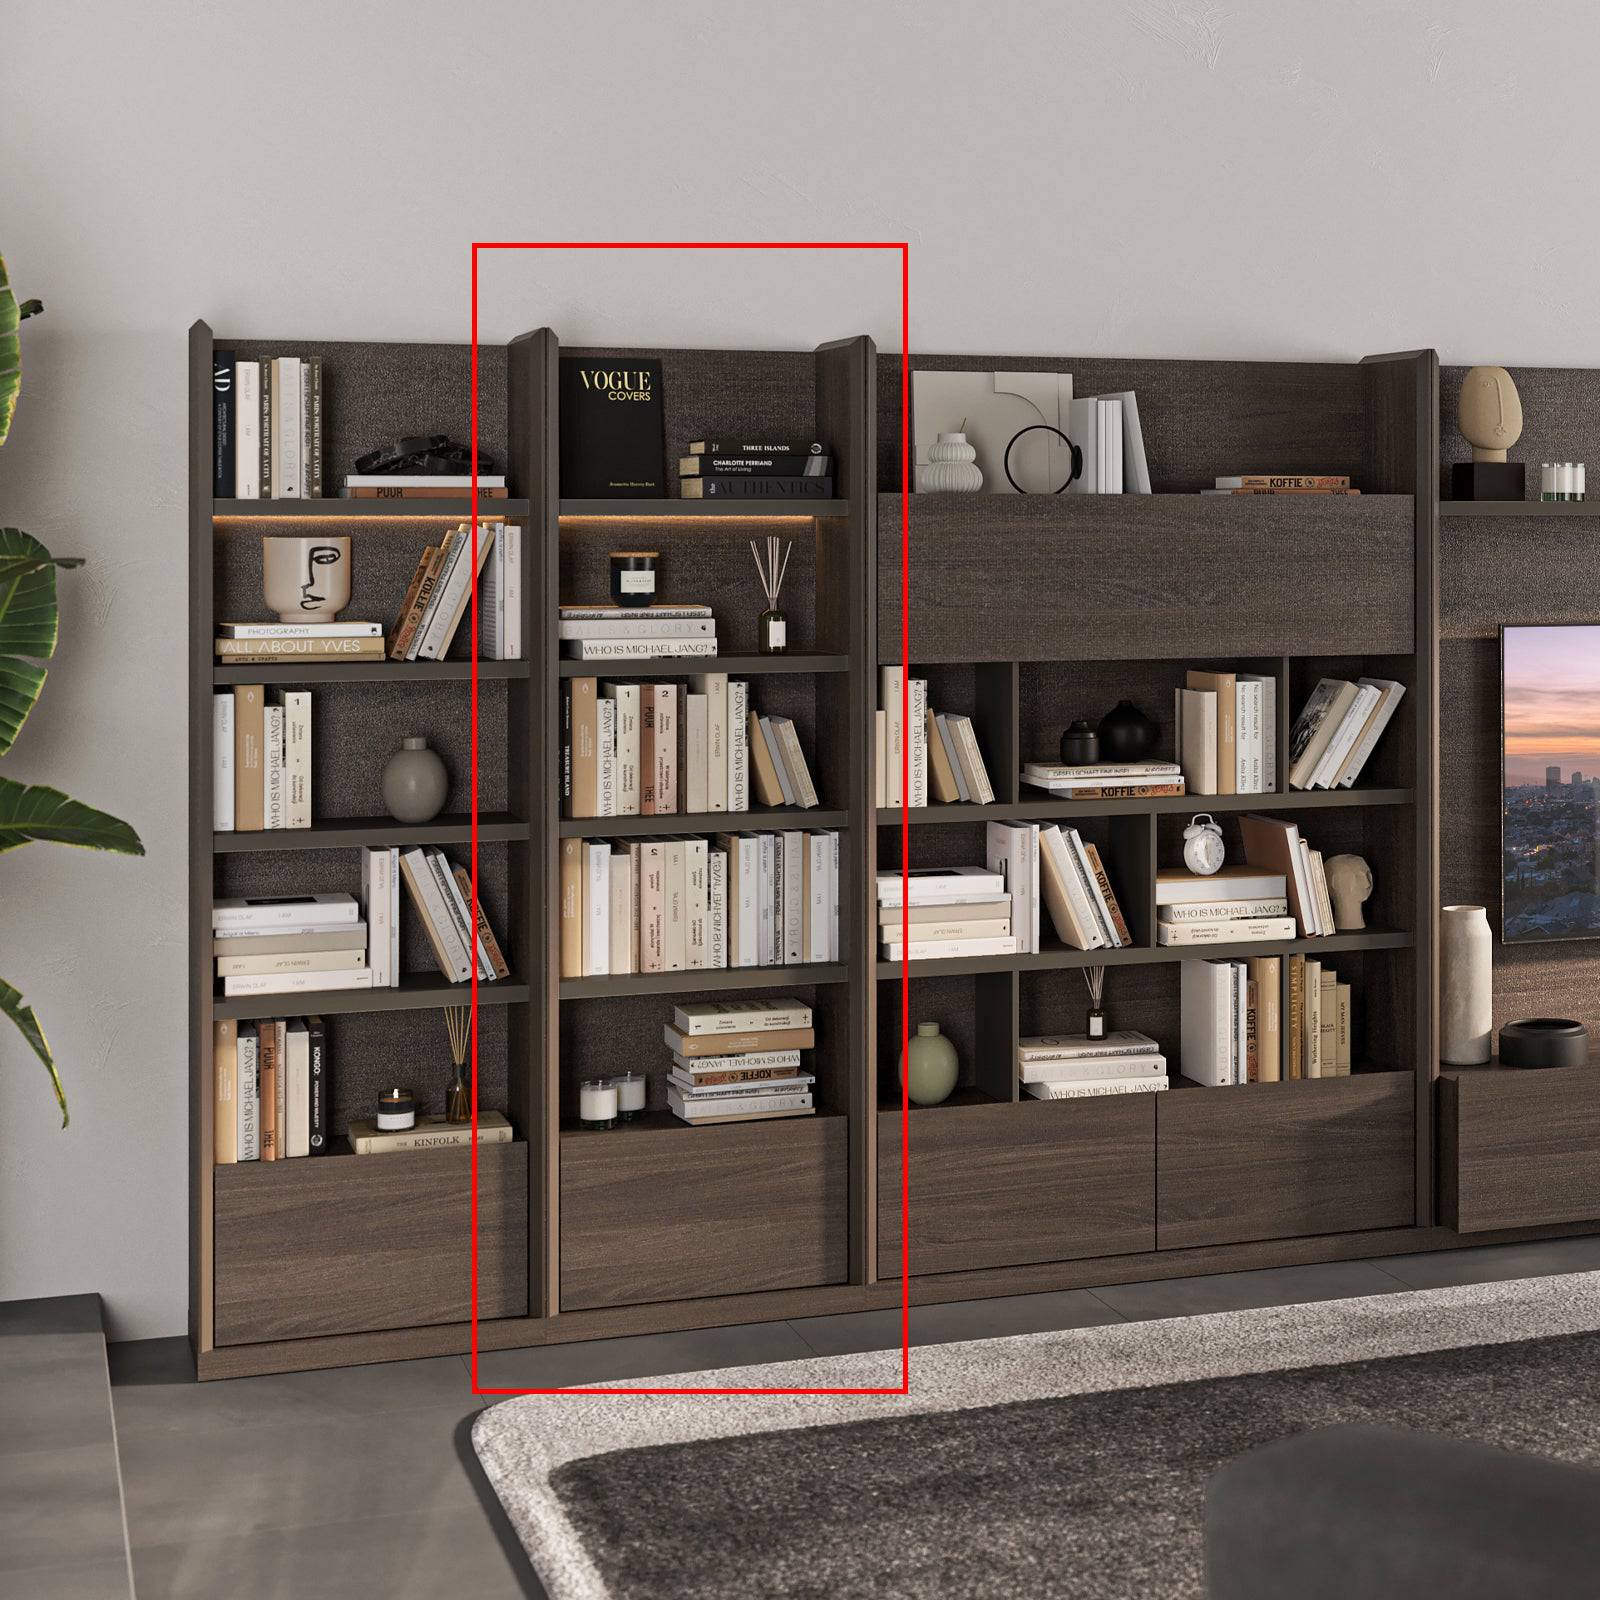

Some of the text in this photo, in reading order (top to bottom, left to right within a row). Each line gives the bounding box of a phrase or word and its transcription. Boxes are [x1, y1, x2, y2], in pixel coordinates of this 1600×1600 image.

[214, 363, 232, 392] AD
[579, 370, 651, 391] VOGUE
[608, 391, 651, 401] COVERS
[717, 480, 826, 494] AUTHENTICS
[1270, 478, 1303, 488] KOFFIE
[377, 487, 403, 498] PUUR
[473, 487, 493, 498] HEE
[413, 576, 436, 612] KOFFIE
[248, 628, 310, 636] PHOTOGRAPHY
[638, 623, 694, 634] GLORY
[223, 640, 361, 653] ALL ABOUT YVES
[584, 644, 708, 655] WHO IS MICHAEL JANG?
[645, 706, 654, 728] PUUR
[735, 692, 745, 811] WHO IS MICHAEL JANG?
[914, 689, 923, 808] WHO IS MICHAEL JANG?
[603, 707, 612, 816] WHO IS MICHAEL JANG?
[271, 715, 281, 830] WHO IS MICHAEL JANG?
[645, 785, 654, 802] THEE
[1101, 786, 1136, 797] KOFFIE
[1095, 870, 1114, 902] KOFFIE
[1173, 905, 1280, 919] WHO IS MICHAEL JANG?
[1247, 1008, 1257, 1041] KOFFIE
[264, 1047, 275, 1070] PUUR
[313, 1046, 321, 1074] KONGO
[697, 1055, 800, 1069] WHO IS MICHAEL JANG?
[741, 1069, 772, 1081] KOFFIE
[1095, 1063, 1146, 1075] GLORY
[1050, 1083, 1160, 1100] WHO IS MICHAEL JANG?
[244, 1045, 254, 1160] WHO IS MICHAEL JANG?
[414, 1136, 460, 1148] KINFOLK
